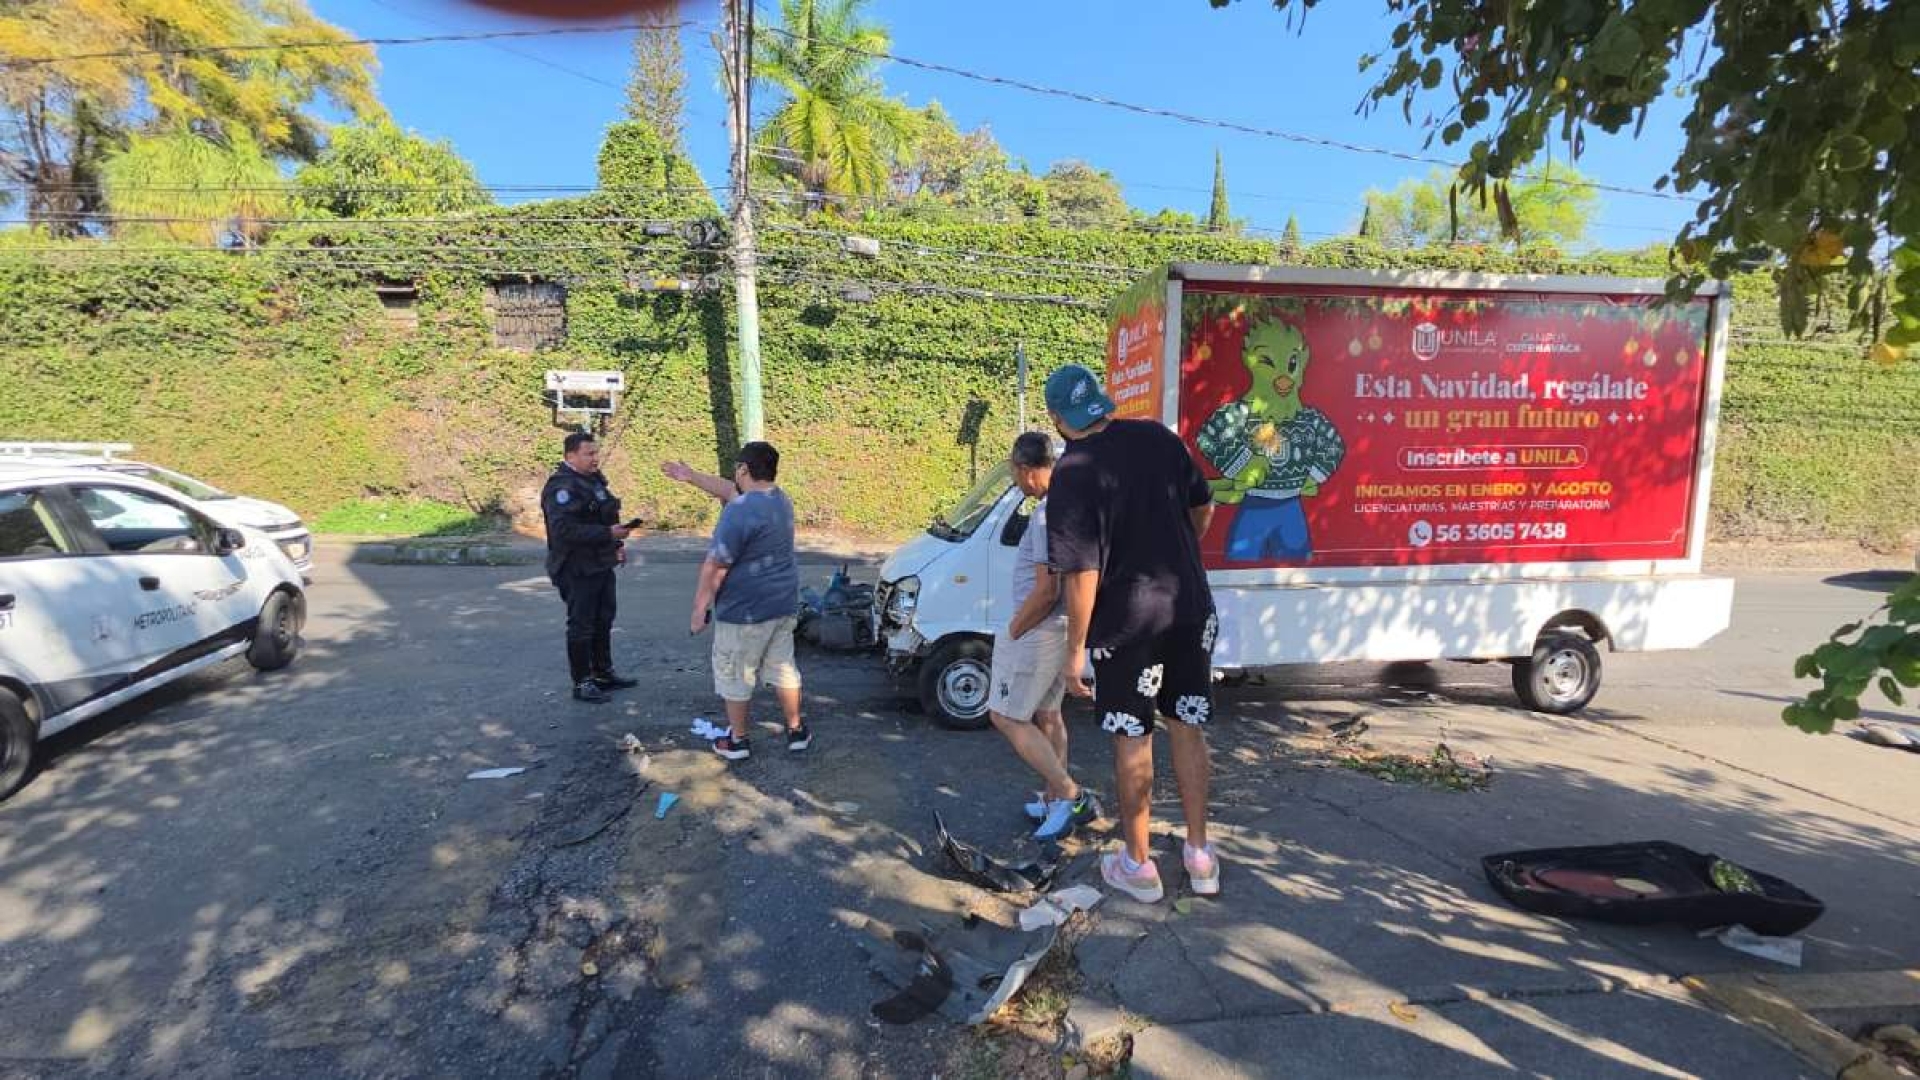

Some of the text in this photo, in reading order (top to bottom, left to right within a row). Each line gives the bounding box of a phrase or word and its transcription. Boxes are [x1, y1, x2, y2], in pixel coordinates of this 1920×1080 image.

[1440, 329, 1498, 347] UNILA
[1354, 370, 1649, 406] Esta Navidad, regálate
[1404, 404, 1600, 433] un gran futuro
[1406, 448, 1580, 467] Inscríbete a UNILA
[1354, 481, 1613, 498] INICIAMOS EN ENERO Y AGOSTO
[1517, 500, 1528, 511] Y
[1529, 499, 1611, 511] PREPARATORIA
[1434, 521, 1567, 542] 56 3605 7438
